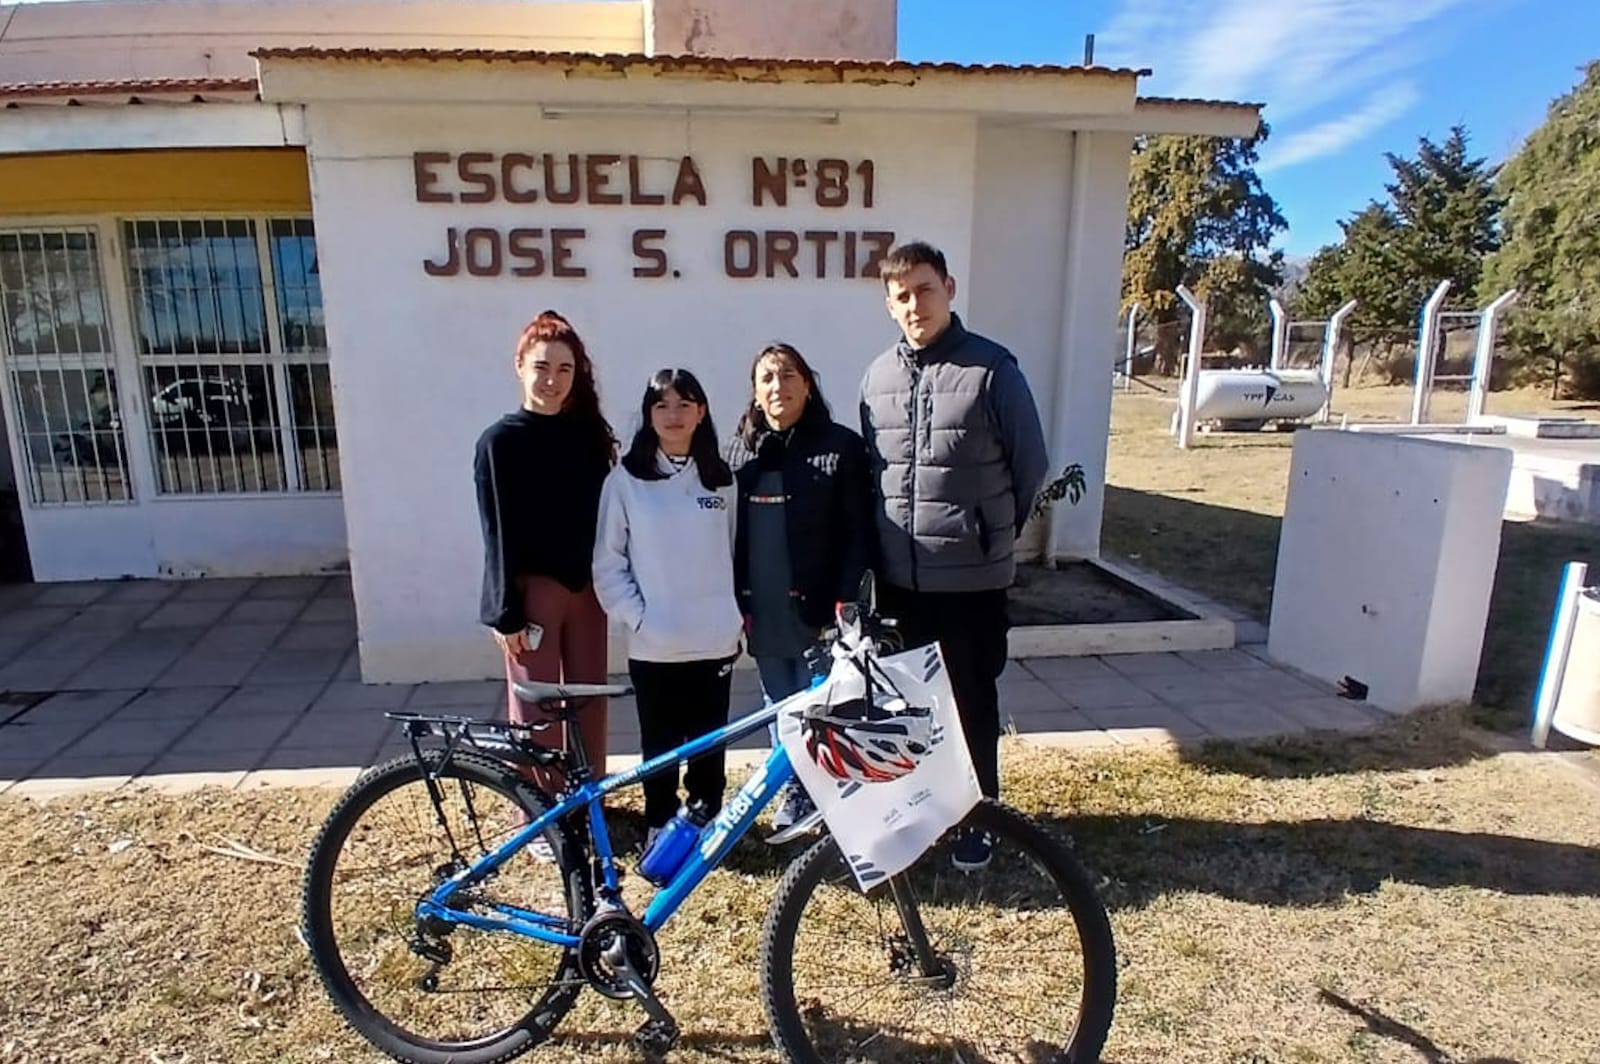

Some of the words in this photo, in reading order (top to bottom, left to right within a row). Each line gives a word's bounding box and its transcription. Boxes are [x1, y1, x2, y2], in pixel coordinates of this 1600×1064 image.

[413, 152, 706, 206] ESCUELA
[423, 227, 587, 277] JOSE
[632, 229, 682, 278] S.
[724, 230, 896, 278] ORTIZ
